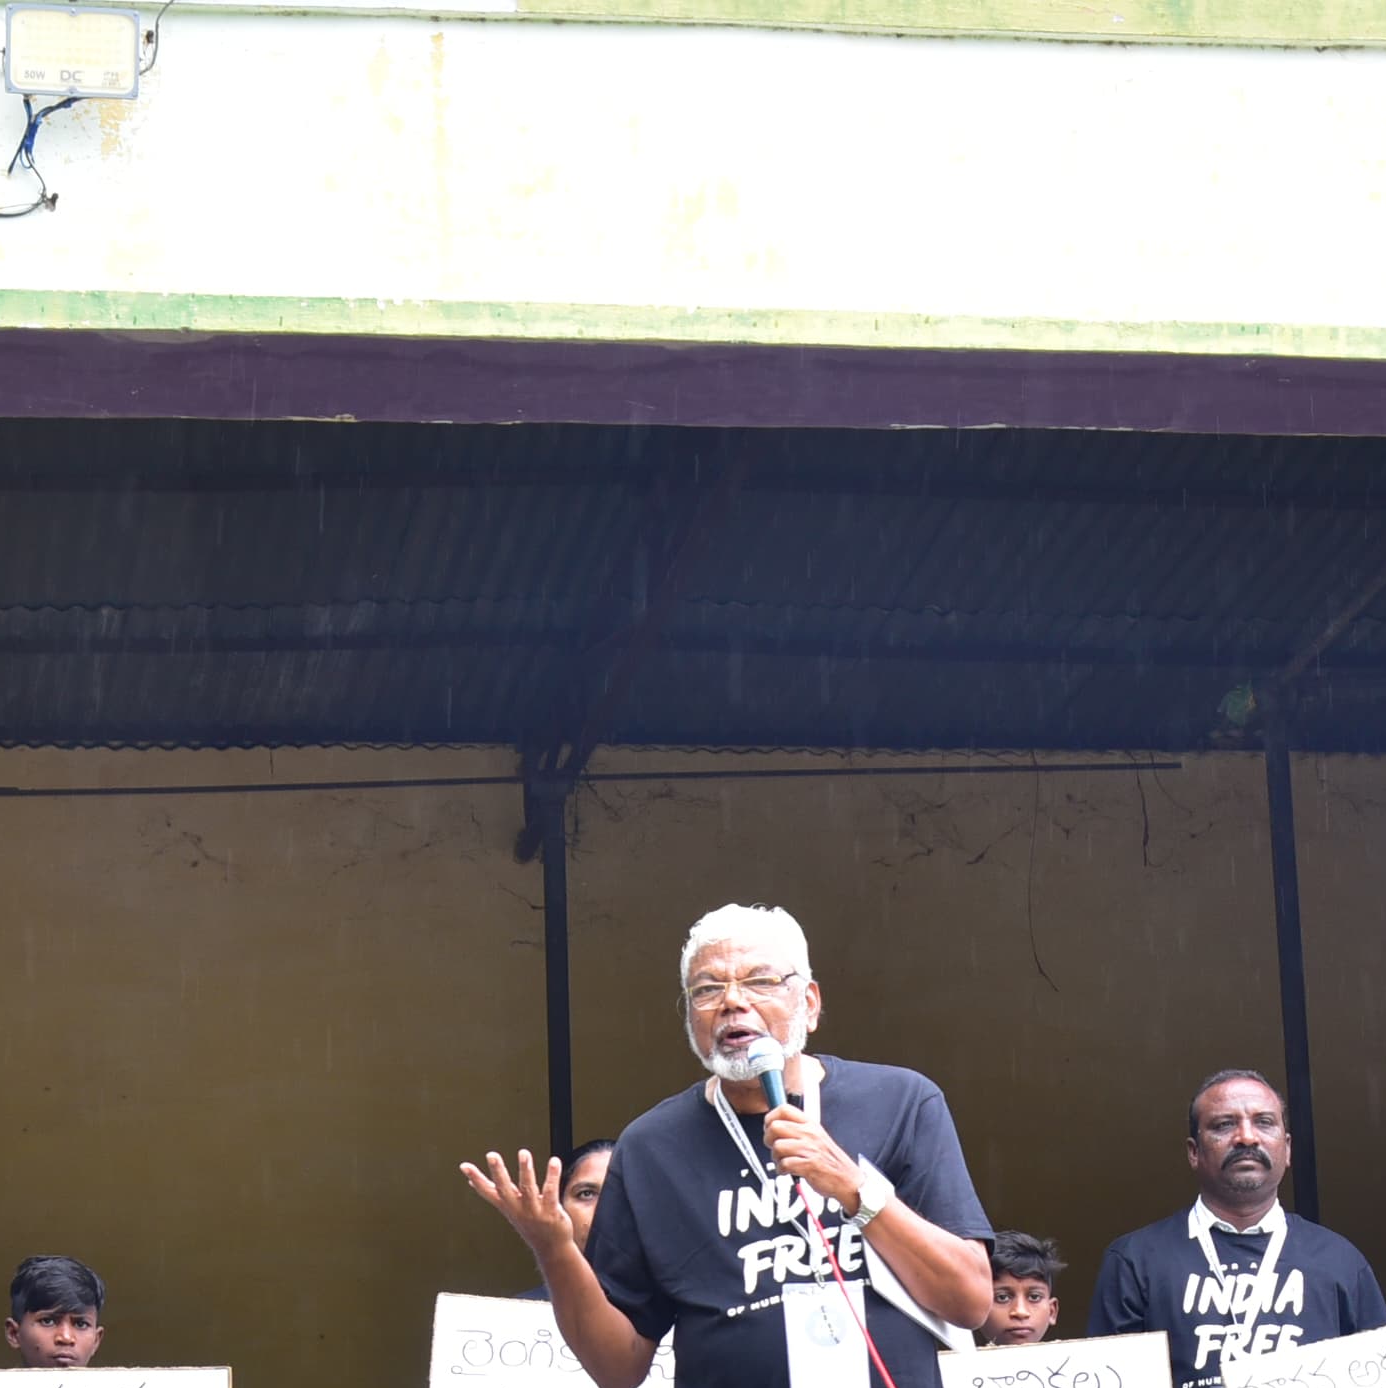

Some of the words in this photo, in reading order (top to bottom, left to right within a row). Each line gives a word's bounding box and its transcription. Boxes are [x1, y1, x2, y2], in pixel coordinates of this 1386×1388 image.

[1183, 1269, 1304, 1316] INDIA
[750, 1296, 783, 1310] HUM
[1198, 1377, 1222, 1387] HUM
